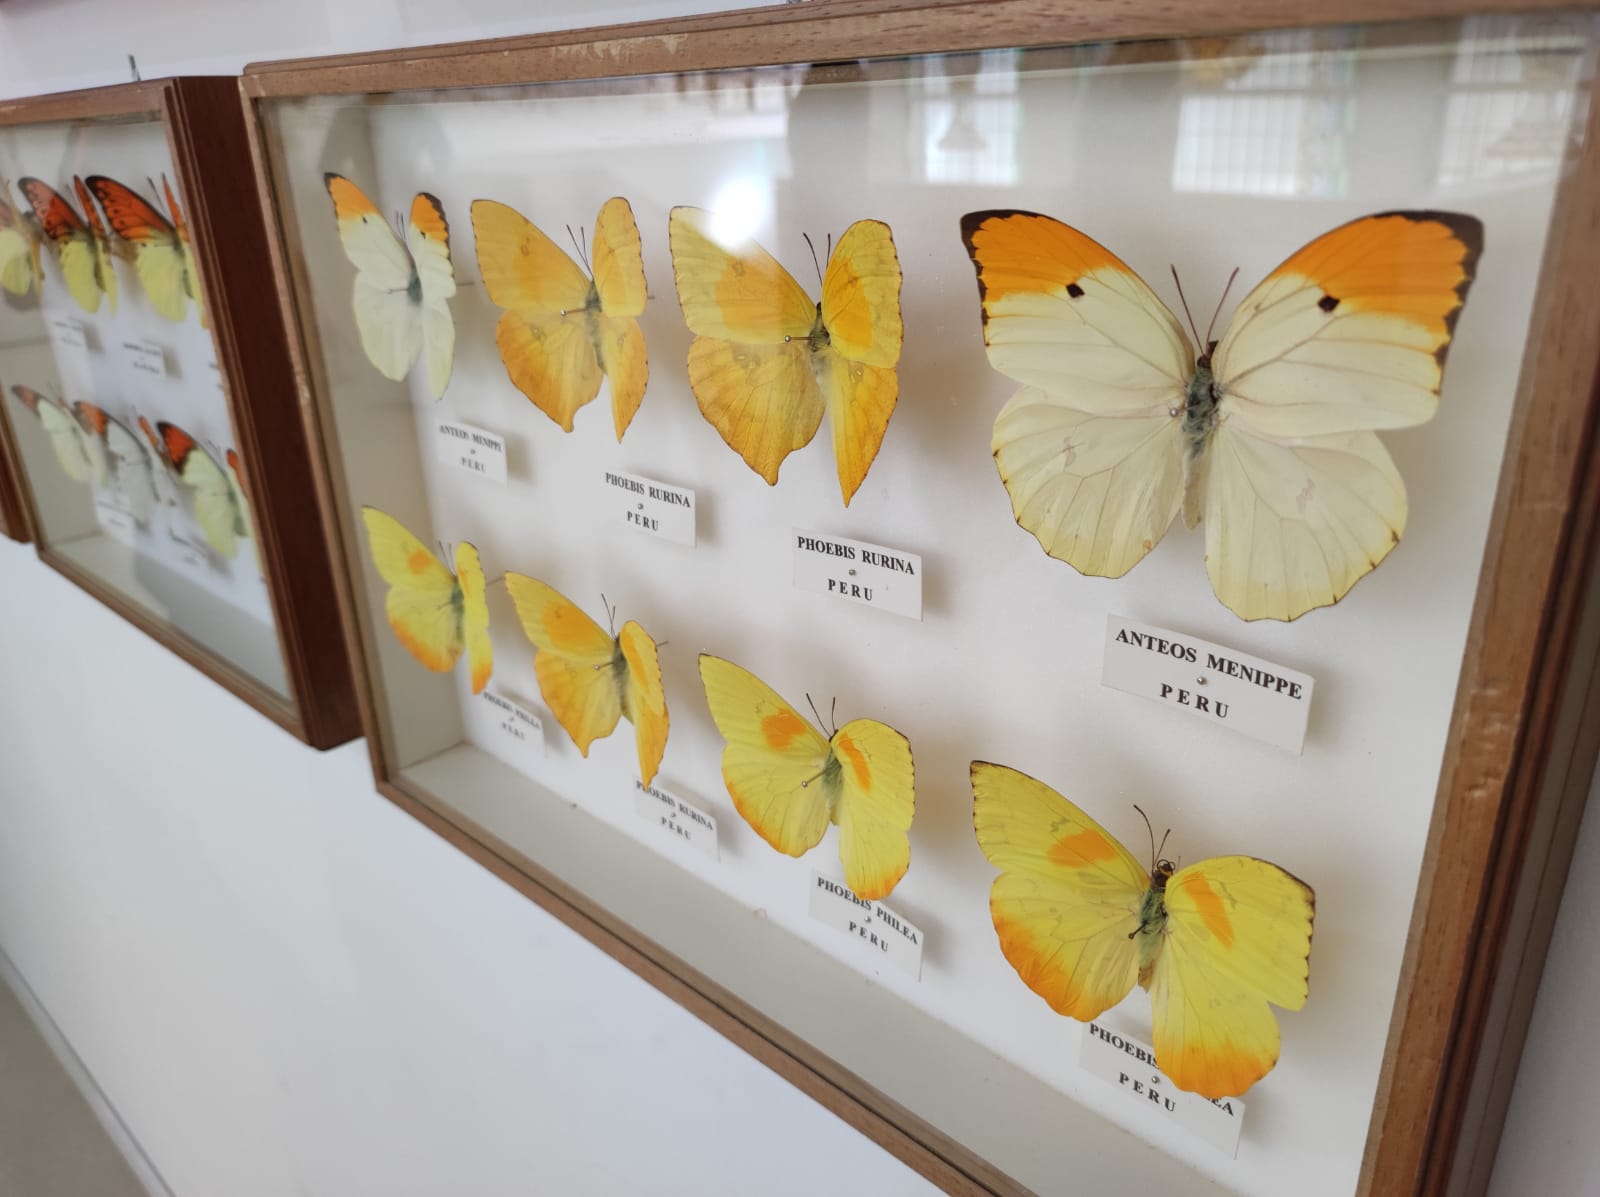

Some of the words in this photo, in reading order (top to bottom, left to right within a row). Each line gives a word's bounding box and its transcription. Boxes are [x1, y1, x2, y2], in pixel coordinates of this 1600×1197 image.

[461, 456, 486, 472] PERU
[605, 472, 645, 495] PHOEBIS
[649, 486, 691, 508] RURINA
[627, 511, 659, 531] PERU
[797, 536, 856, 560] PHOEBIS
[862, 549, 915, 575] RURINA
[828, 578, 873, 601] PERU
[1115, 628, 1197, 663] ANTEOS
[1206, 653, 1302, 700] MENIPPE
[1160, 683, 1229, 718] PERU
[636, 780, 676, 807] POEBIS
[679, 803, 713, 830] RURINA
[661, 816, 691, 840] PERU
[817, 876, 872, 911] PHOEBIS
[876, 906, 918, 944] PHILEA
[849, 921, 888, 952] PERU
[1119, 1071, 1176, 1112] PERU
